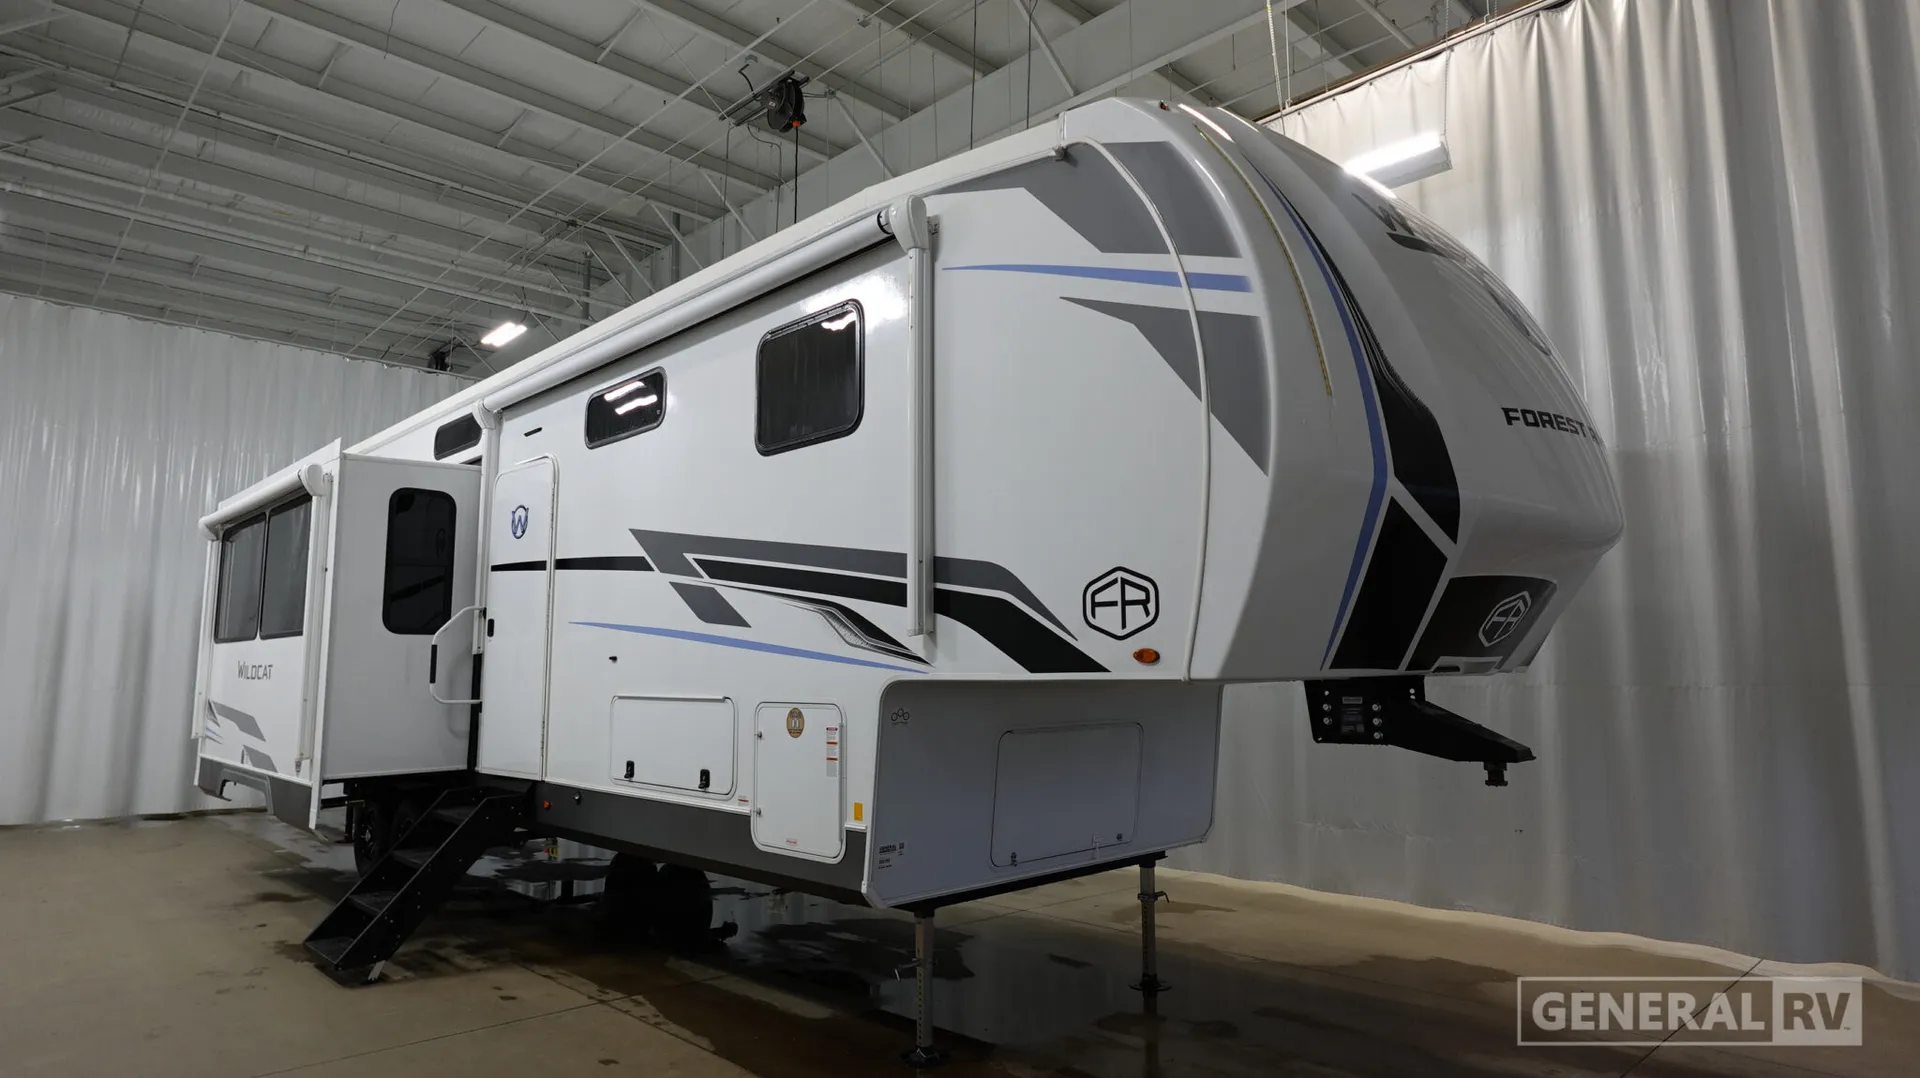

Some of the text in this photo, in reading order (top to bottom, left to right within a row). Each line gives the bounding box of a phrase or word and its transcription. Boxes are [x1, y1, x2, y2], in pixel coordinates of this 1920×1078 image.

[1501, 407, 1587, 438] FOREST
[1091, 576, 1150, 630] FR
[237, 660, 273, 680] WILDCAT
